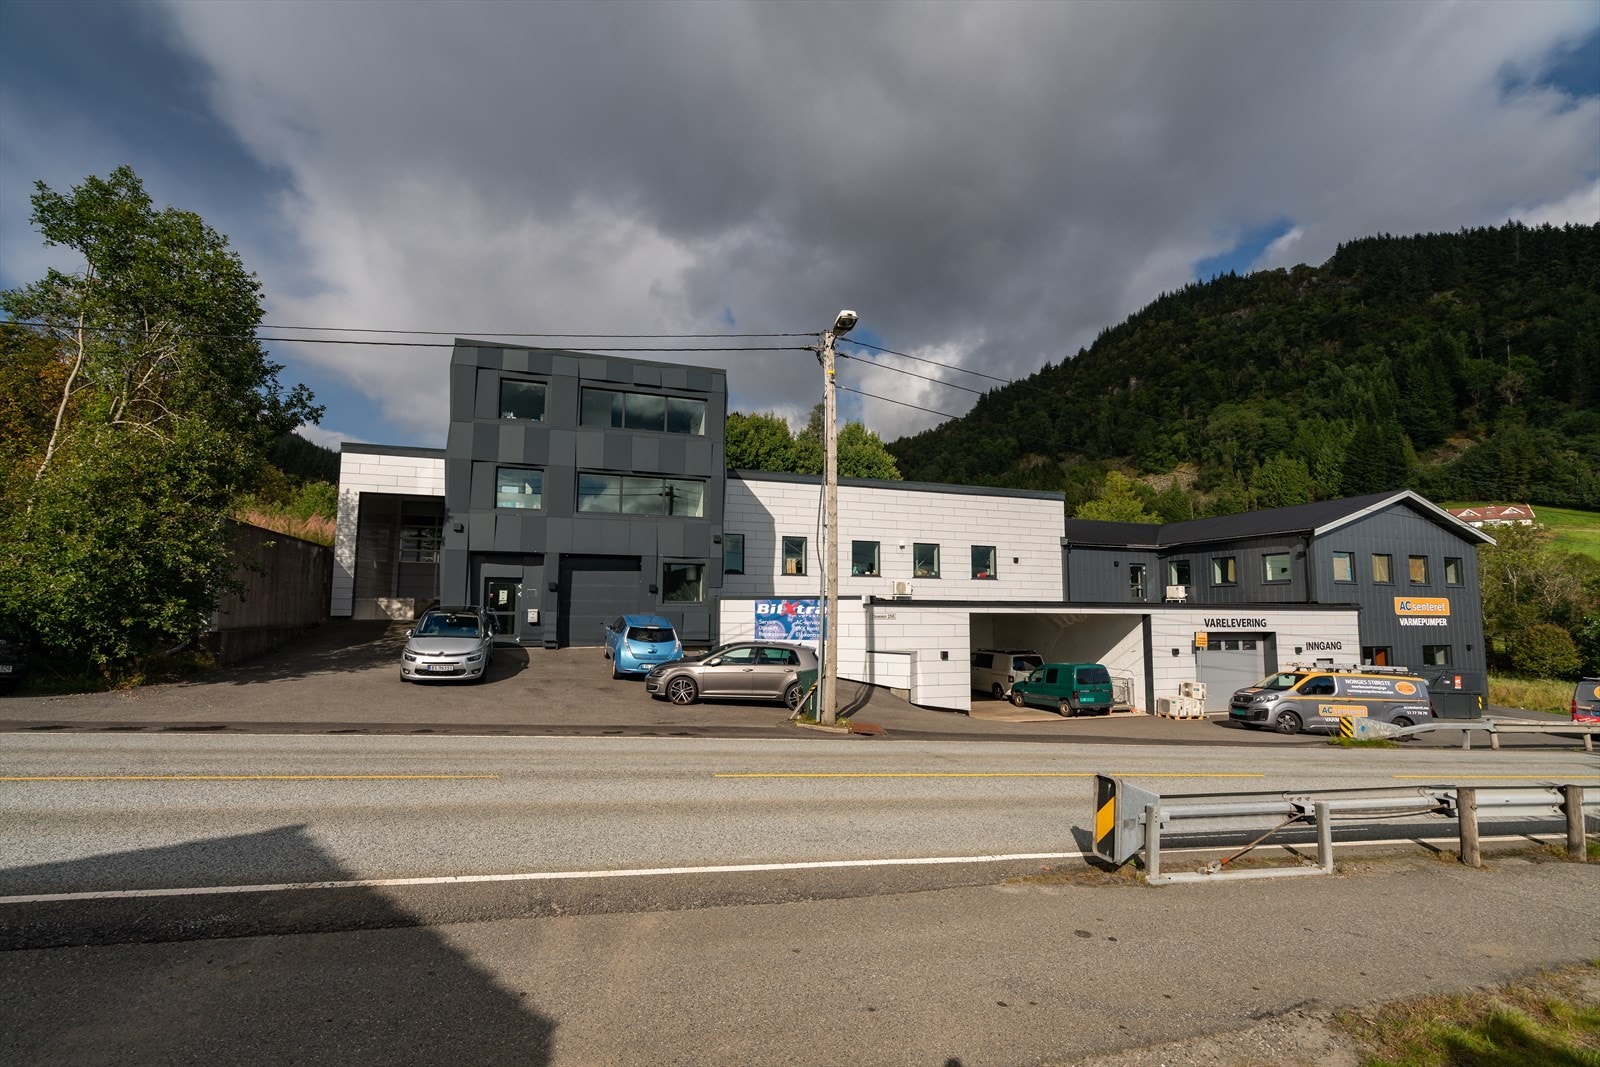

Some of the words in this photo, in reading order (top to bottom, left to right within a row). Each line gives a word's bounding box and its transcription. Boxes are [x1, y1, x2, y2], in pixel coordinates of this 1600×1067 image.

[1399, 601, 1411, 611] AC
[1412, 602, 1446, 612] senteret
[1203, 618, 1267, 628] VARELEVERING
[1398, 617, 1448, 626] VARMEPUMPER
[1305, 641, 1342, 651] INNGANG
